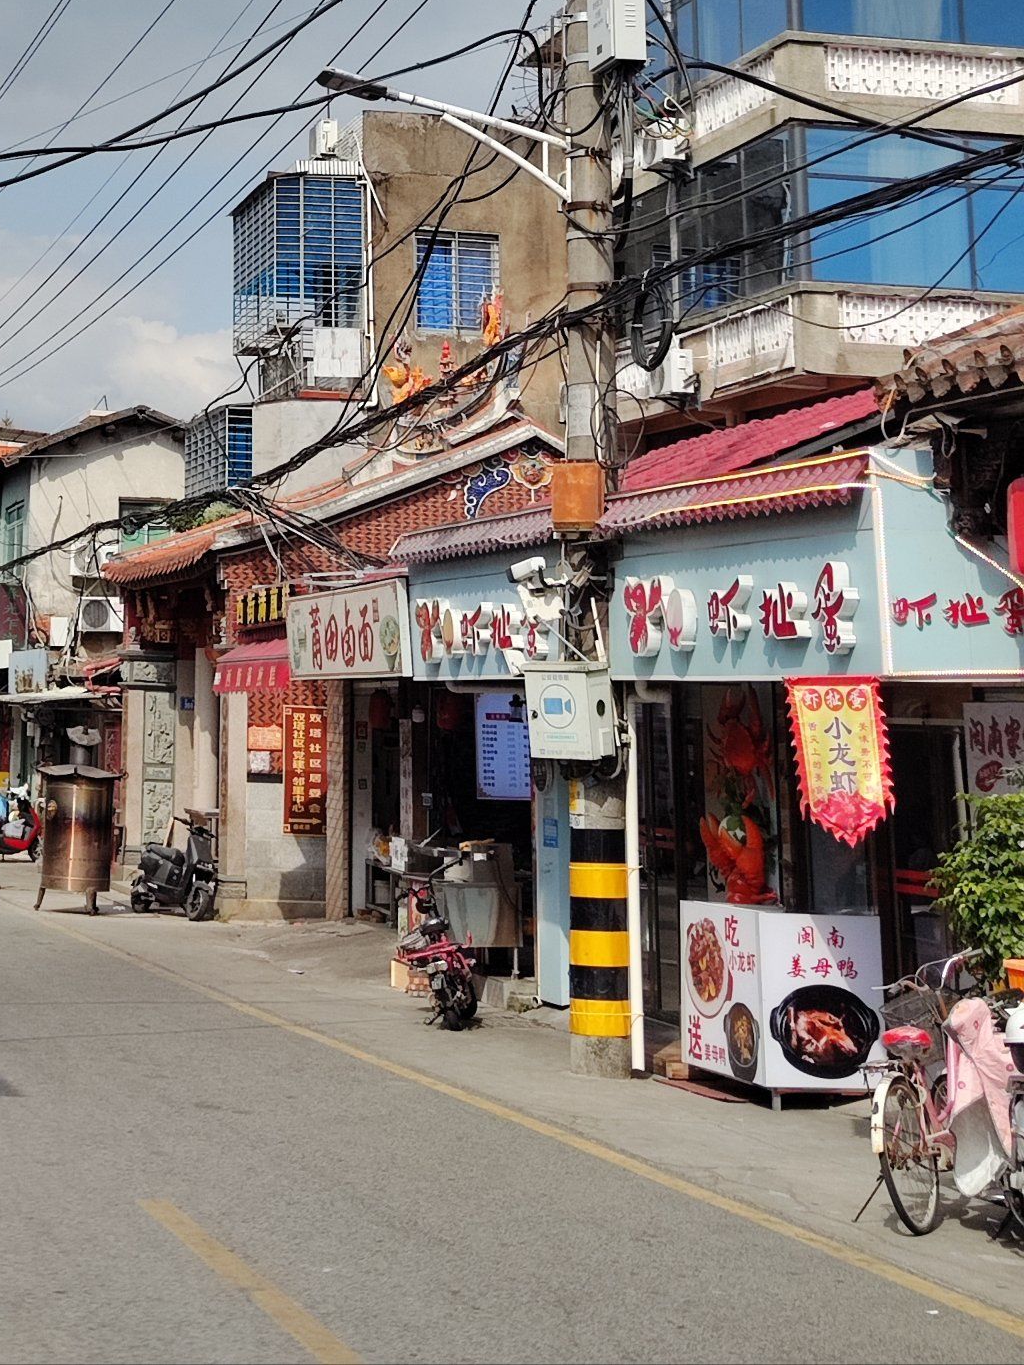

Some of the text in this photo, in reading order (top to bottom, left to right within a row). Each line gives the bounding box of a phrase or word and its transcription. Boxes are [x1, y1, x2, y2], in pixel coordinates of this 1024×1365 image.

[707, 561, 846, 654] 虾扯蛋
[309, 599, 373, 671] 莆田卤面
[309, 713, 322, 813] 双塔社区居委会
[824, 716, 858, 794] 小龙虾
[724, 914, 740, 947] 吃
[797, 926, 845, 949] 闽南
[728, 950, 756, 975] 小龙虾
[787, 954, 859, 980] 姜母鸭
[688, 1014, 703, 1061] 送
